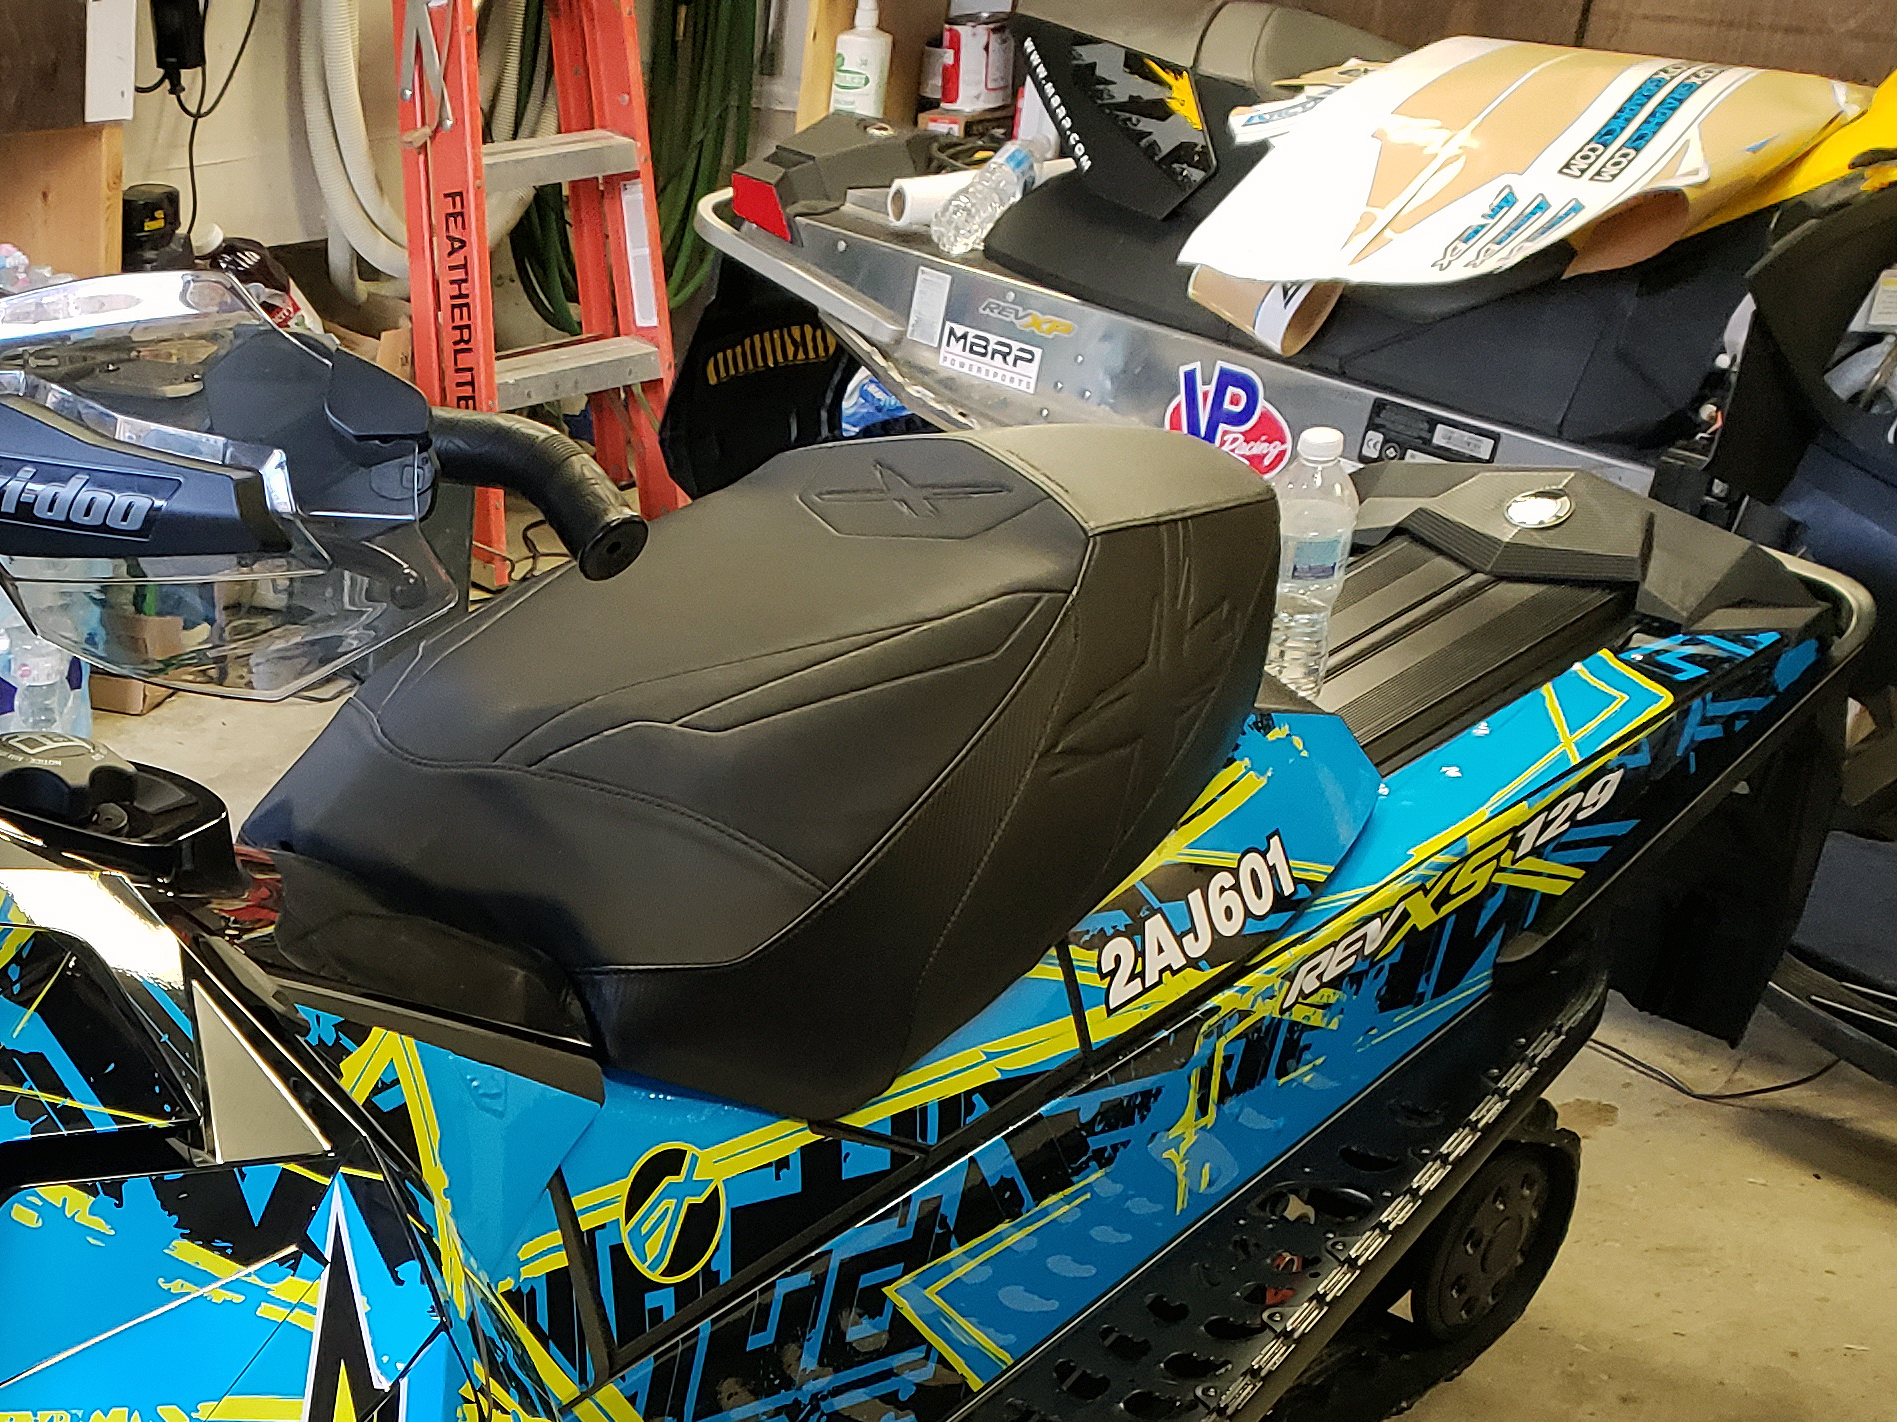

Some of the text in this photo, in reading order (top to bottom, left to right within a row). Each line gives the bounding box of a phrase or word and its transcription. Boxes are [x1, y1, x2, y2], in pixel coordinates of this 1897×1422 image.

[443, 191, 477, 411] FEATHERLITE
[941, 355, 1032, 391] POWERSPORTS
[945, 325, 1036, 368] MBRP
[1180, 360, 1263, 444] VP
[1513, 767, 1626, 859] 129
[1100, 833, 1296, 1011] 2AJ601
